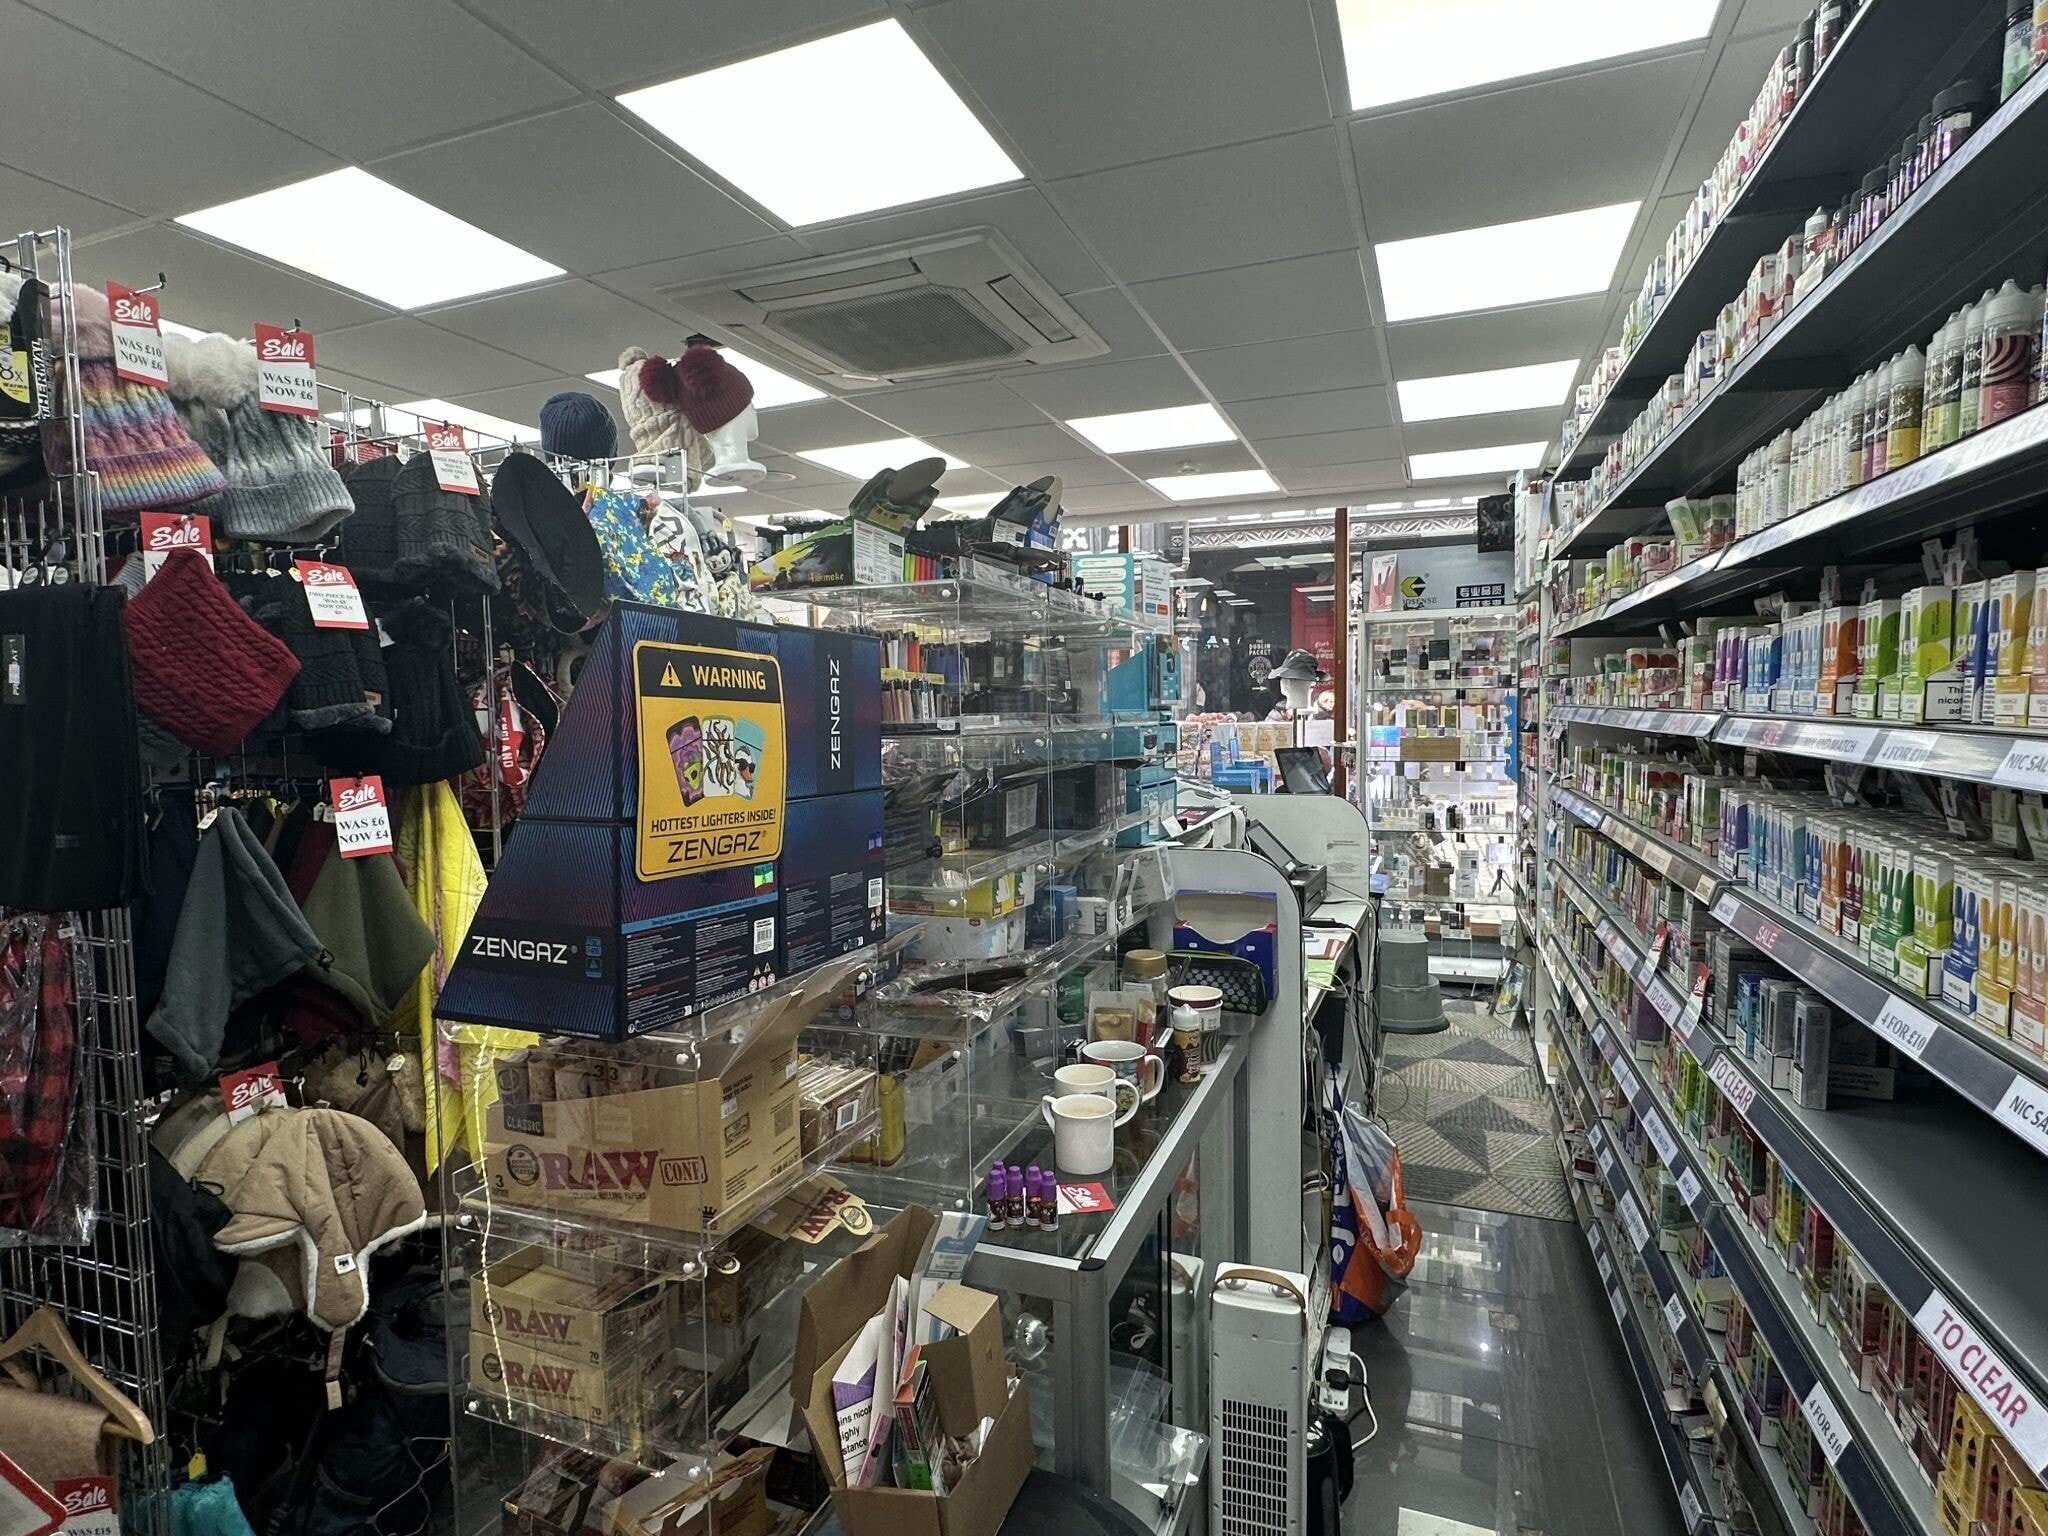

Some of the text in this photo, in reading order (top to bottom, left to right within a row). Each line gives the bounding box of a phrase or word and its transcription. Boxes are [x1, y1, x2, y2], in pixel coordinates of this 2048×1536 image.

[115, 299, 152, 321] Sale
[117, 335, 162, 358] WAS £10
[262, 339, 305, 357] Sale
[120, 350, 163, 371] NOW £6
[262, 371, 314, 388] WAS £10
[265, 385, 313, 401] NOW £6
[431, 433, 460, 447] Sale
[150, 521, 200, 546] Sale
[307, 569, 345, 582] Sale
[692, 665, 766, 690] WARNING
[829, 658, 841, 770] ZENGAZ
[2007, 753, 2048, 773] NIC SAL
[338, 784, 376, 808] Sale
[338, 816, 385, 830] WAS £6
[651, 808, 776, 833] HOTTEST LIGHTERS INSIDE!
[339, 829, 389, 844] NOW £4
[667, 831, 761, 864] ZENGAZ
[1755, 925, 1778, 949] SALE
[471, 935, 568, 965] ZENGAZ
[1652, 986, 1672, 1014] TO CLEAR
[1881, 1012, 1927, 1051] 4 FOR £10
[232, 1076, 272, 1105] Sale
[1711, 1056, 1753, 1112] TO CLEAR
[2009, 1096, 2034, 1120] NIC
[507, 1115, 541, 1133] CLASSIC
[495, 1174, 504, 1188] 3
[539, 1151, 659, 1190] RAW
[503, 1305, 576, 1340] RAW
[589, 1351, 600, 1360] 70
[504, 1361, 576, 1396] RAW
[1933, 1309, 2028, 1428] TO CLEAR
[592, 1407, 602, 1416] 70
[840, 1415, 853, 1428] ins
[841, 1426, 861, 1442] ighly
[1809, 1399, 1843, 1456] 4 FOR £10
[842, 1437, 868, 1456] stance
[64, 1486, 107, 1511] Sale
[67, 1526, 112, 1536] WAS £15
